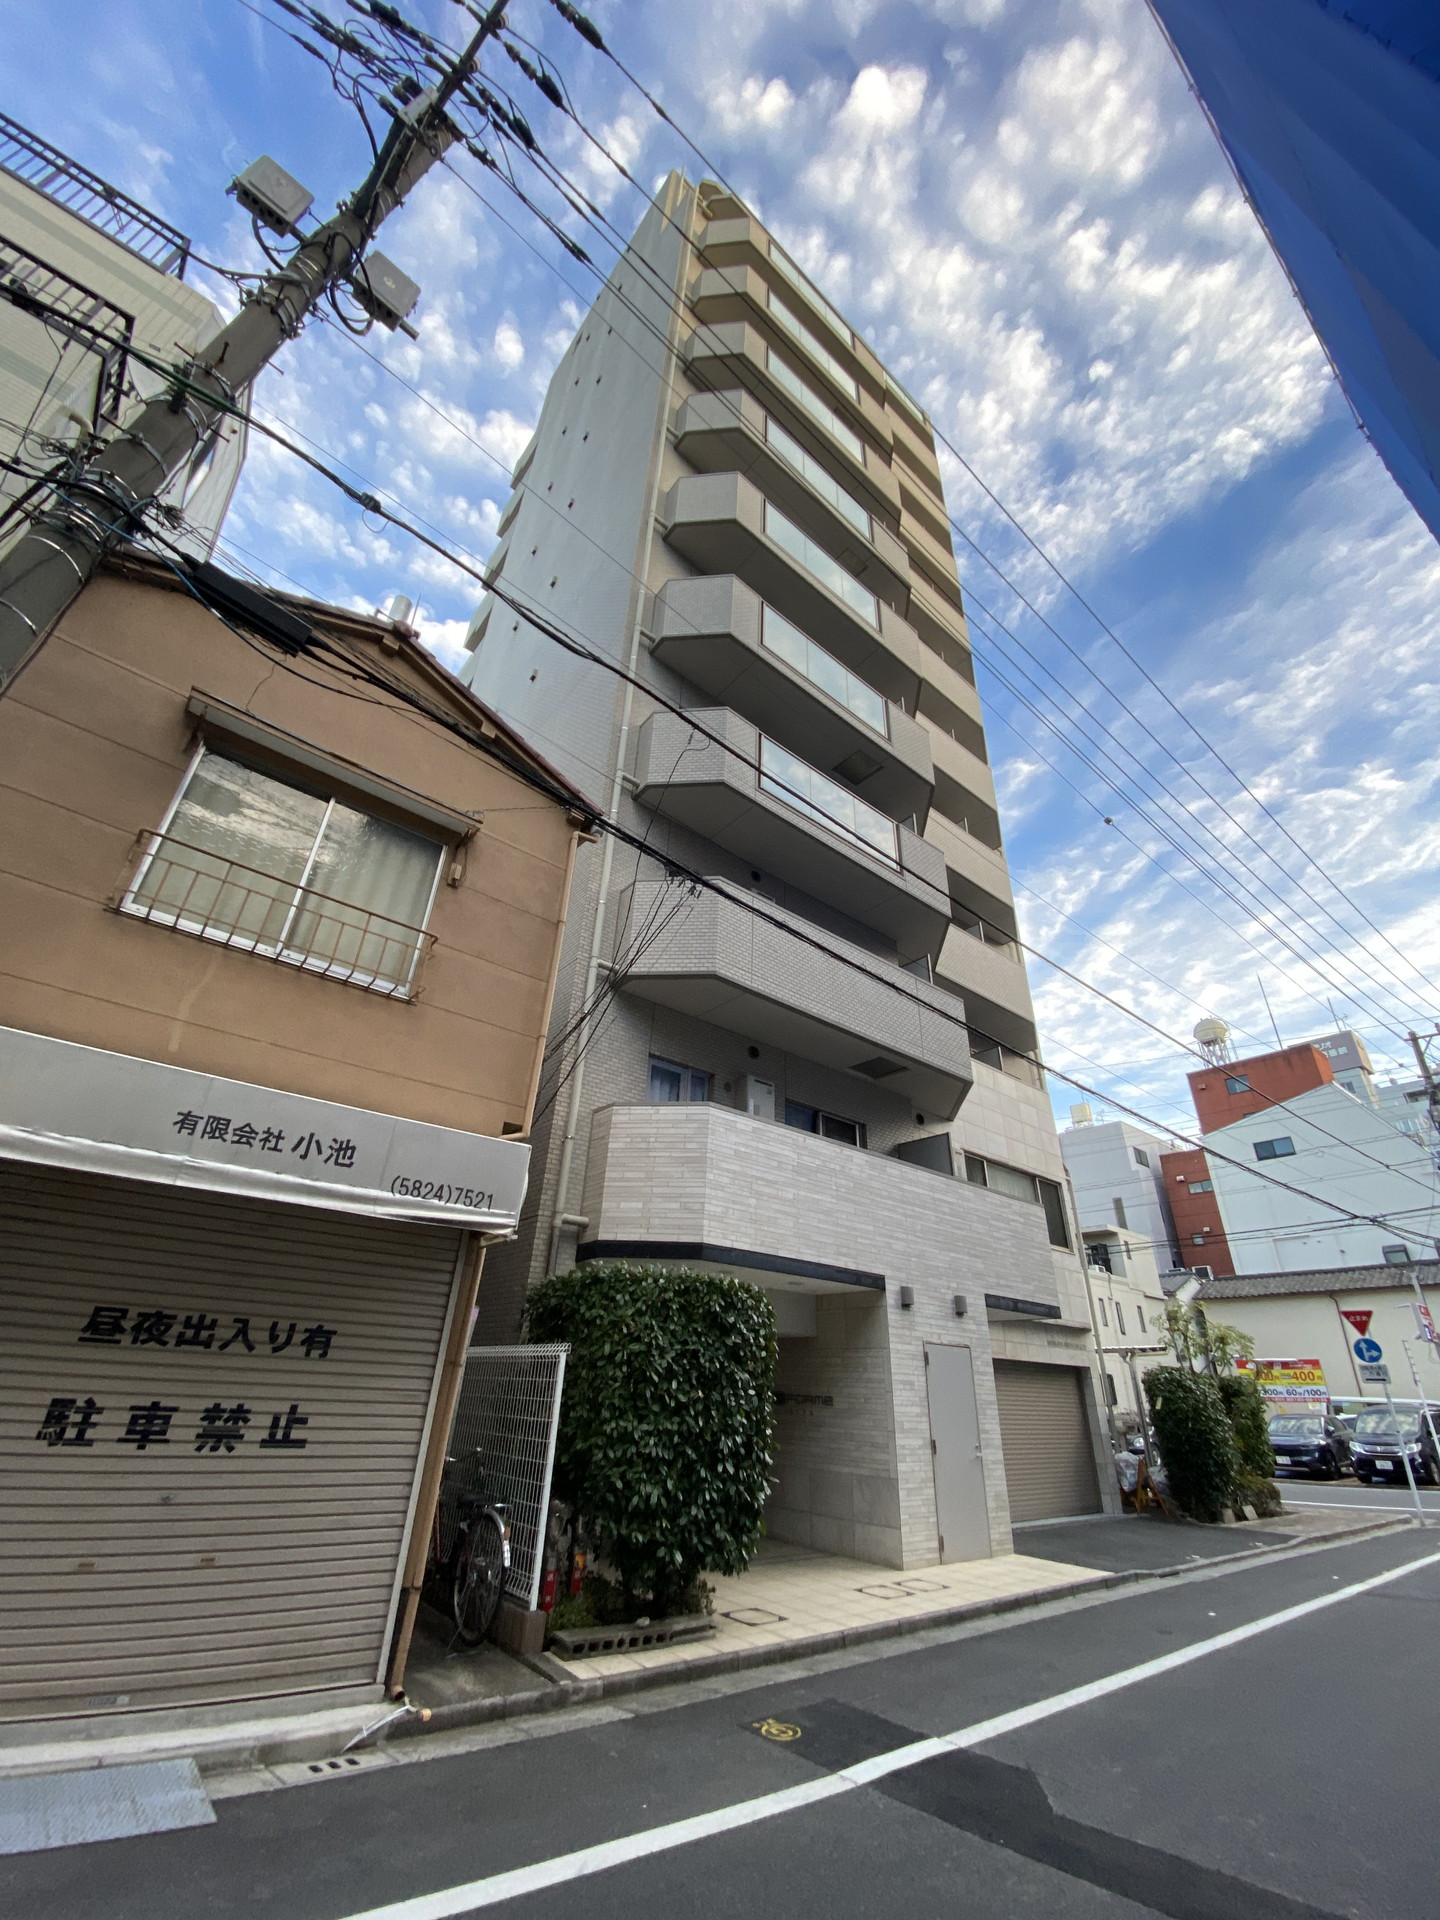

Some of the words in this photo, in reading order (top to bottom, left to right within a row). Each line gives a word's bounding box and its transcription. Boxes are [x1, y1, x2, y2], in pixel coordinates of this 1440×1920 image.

[390, 1175, 494, 1212] (5824)7521
[77, 1306, 338, 1359] 昼夜出入り有
[35, 1397, 310, 1453] 駐車禁止
